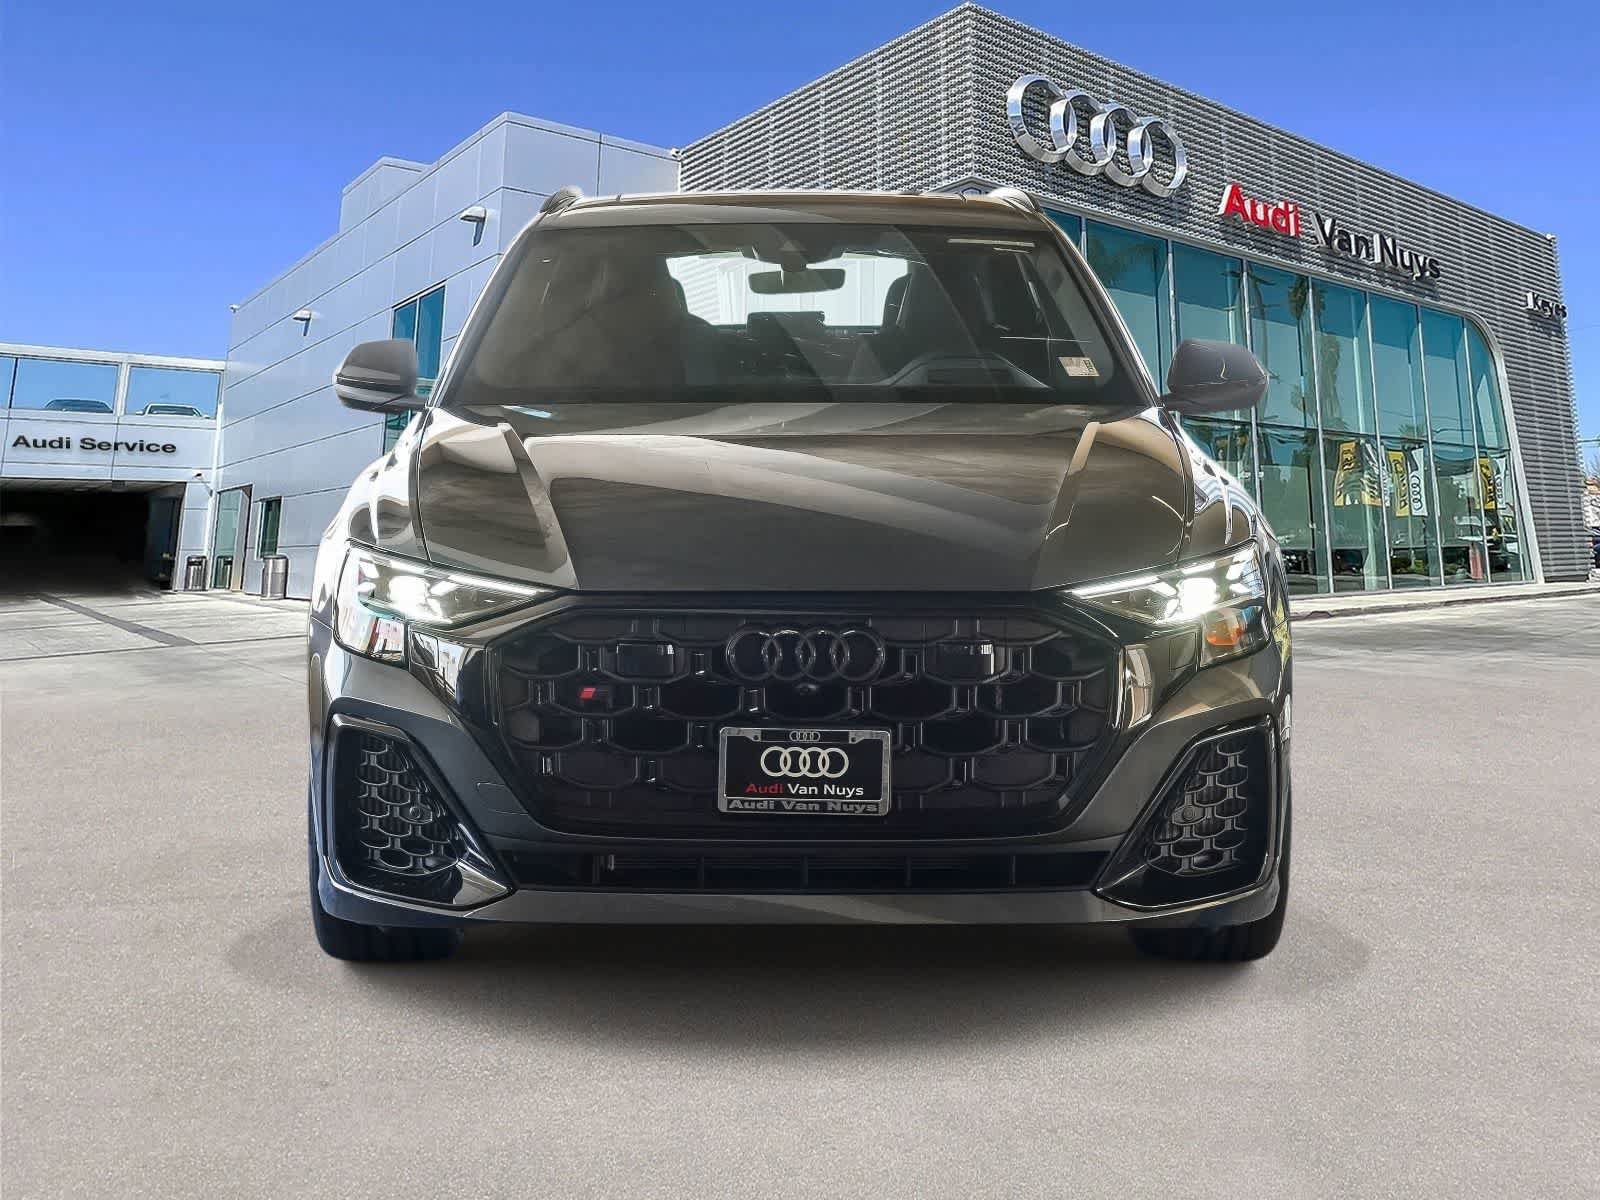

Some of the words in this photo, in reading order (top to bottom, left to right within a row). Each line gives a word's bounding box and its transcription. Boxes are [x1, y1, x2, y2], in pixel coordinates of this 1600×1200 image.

[1218, 183, 1302, 237] Audi
[1312, 212, 1373, 257] Van
[1374, 233, 1441, 280] Nuys
[12, 434, 71, 450] Audi
[79, 437, 177, 454] Service
[745, 783, 784, 795] Audi
[787, 783, 818, 796] Van
[823, 784, 865, 798] Nuys
[729, 799, 775, 810] Audi
[781, 801, 821, 812] Van
[827, 801, 879, 813] Nuys
